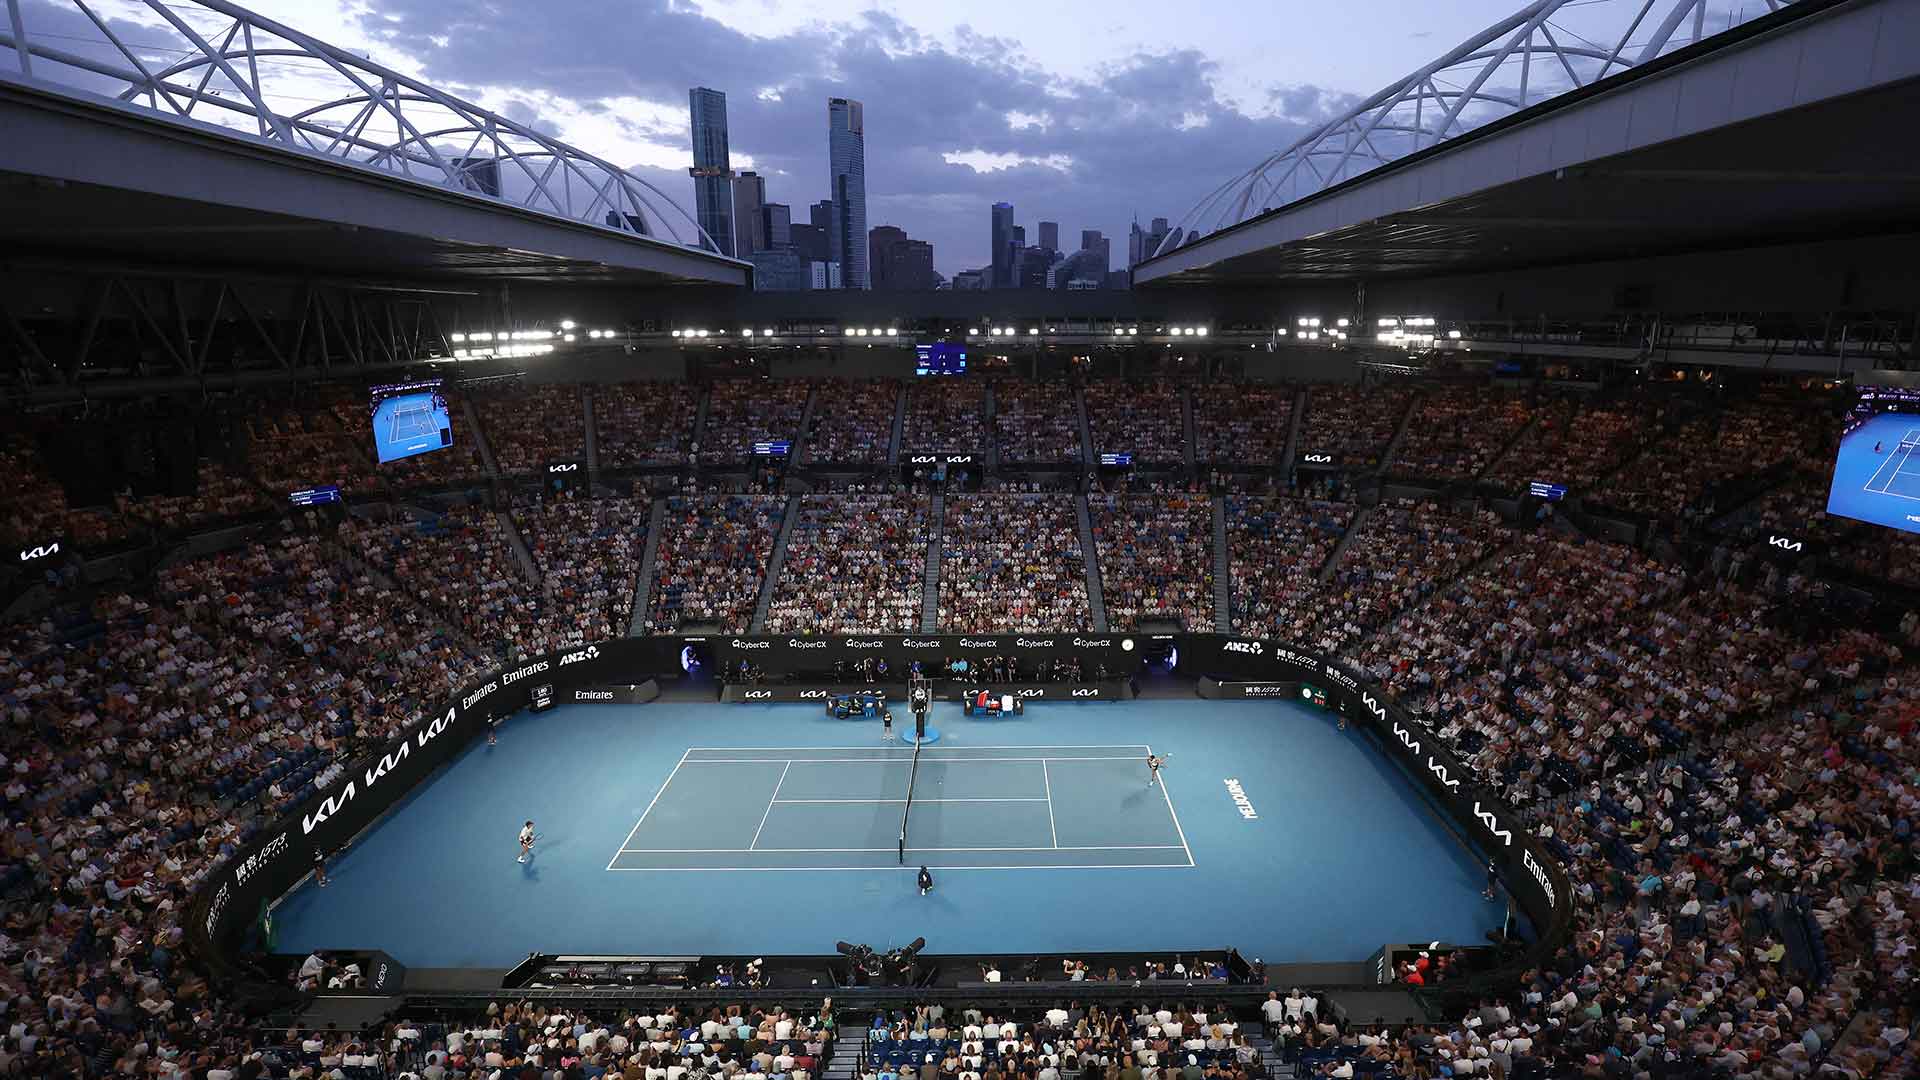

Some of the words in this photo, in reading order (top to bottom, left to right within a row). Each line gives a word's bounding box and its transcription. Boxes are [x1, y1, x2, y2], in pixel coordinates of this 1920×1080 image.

[1304, 454, 1331, 463] KIA
[549, 463, 577, 473] KIA
[1769, 535, 1802, 552] KIA
[20, 543, 59, 561] KIA
[741, 641, 770, 650] CyberCX
[798, 641, 827, 650] CyberCX
[854, 641, 883, 650] CyberCX
[911, 641, 940, 650] CyberCX
[968, 641, 997, 650] CyberCX
[1025, 641, 1054, 650] CyberCX
[1082, 641, 1111, 650] CyberCX
[1224, 641, 1249, 653] ANZ
[559, 650, 586, 666] ANZ
[502, 660, 549, 686] Emirates
[463, 680, 498, 710] Emirates
[575, 690, 614, 700] Emirates
[745, 690, 772, 698] KIA
[800, 690, 827, 698] KIA
[1072, 689, 1099, 697] KIA
[418, 707, 456, 747] KIA
[365, 741, 409, 787] KIA
[302, 782, 356, 835] KIA
